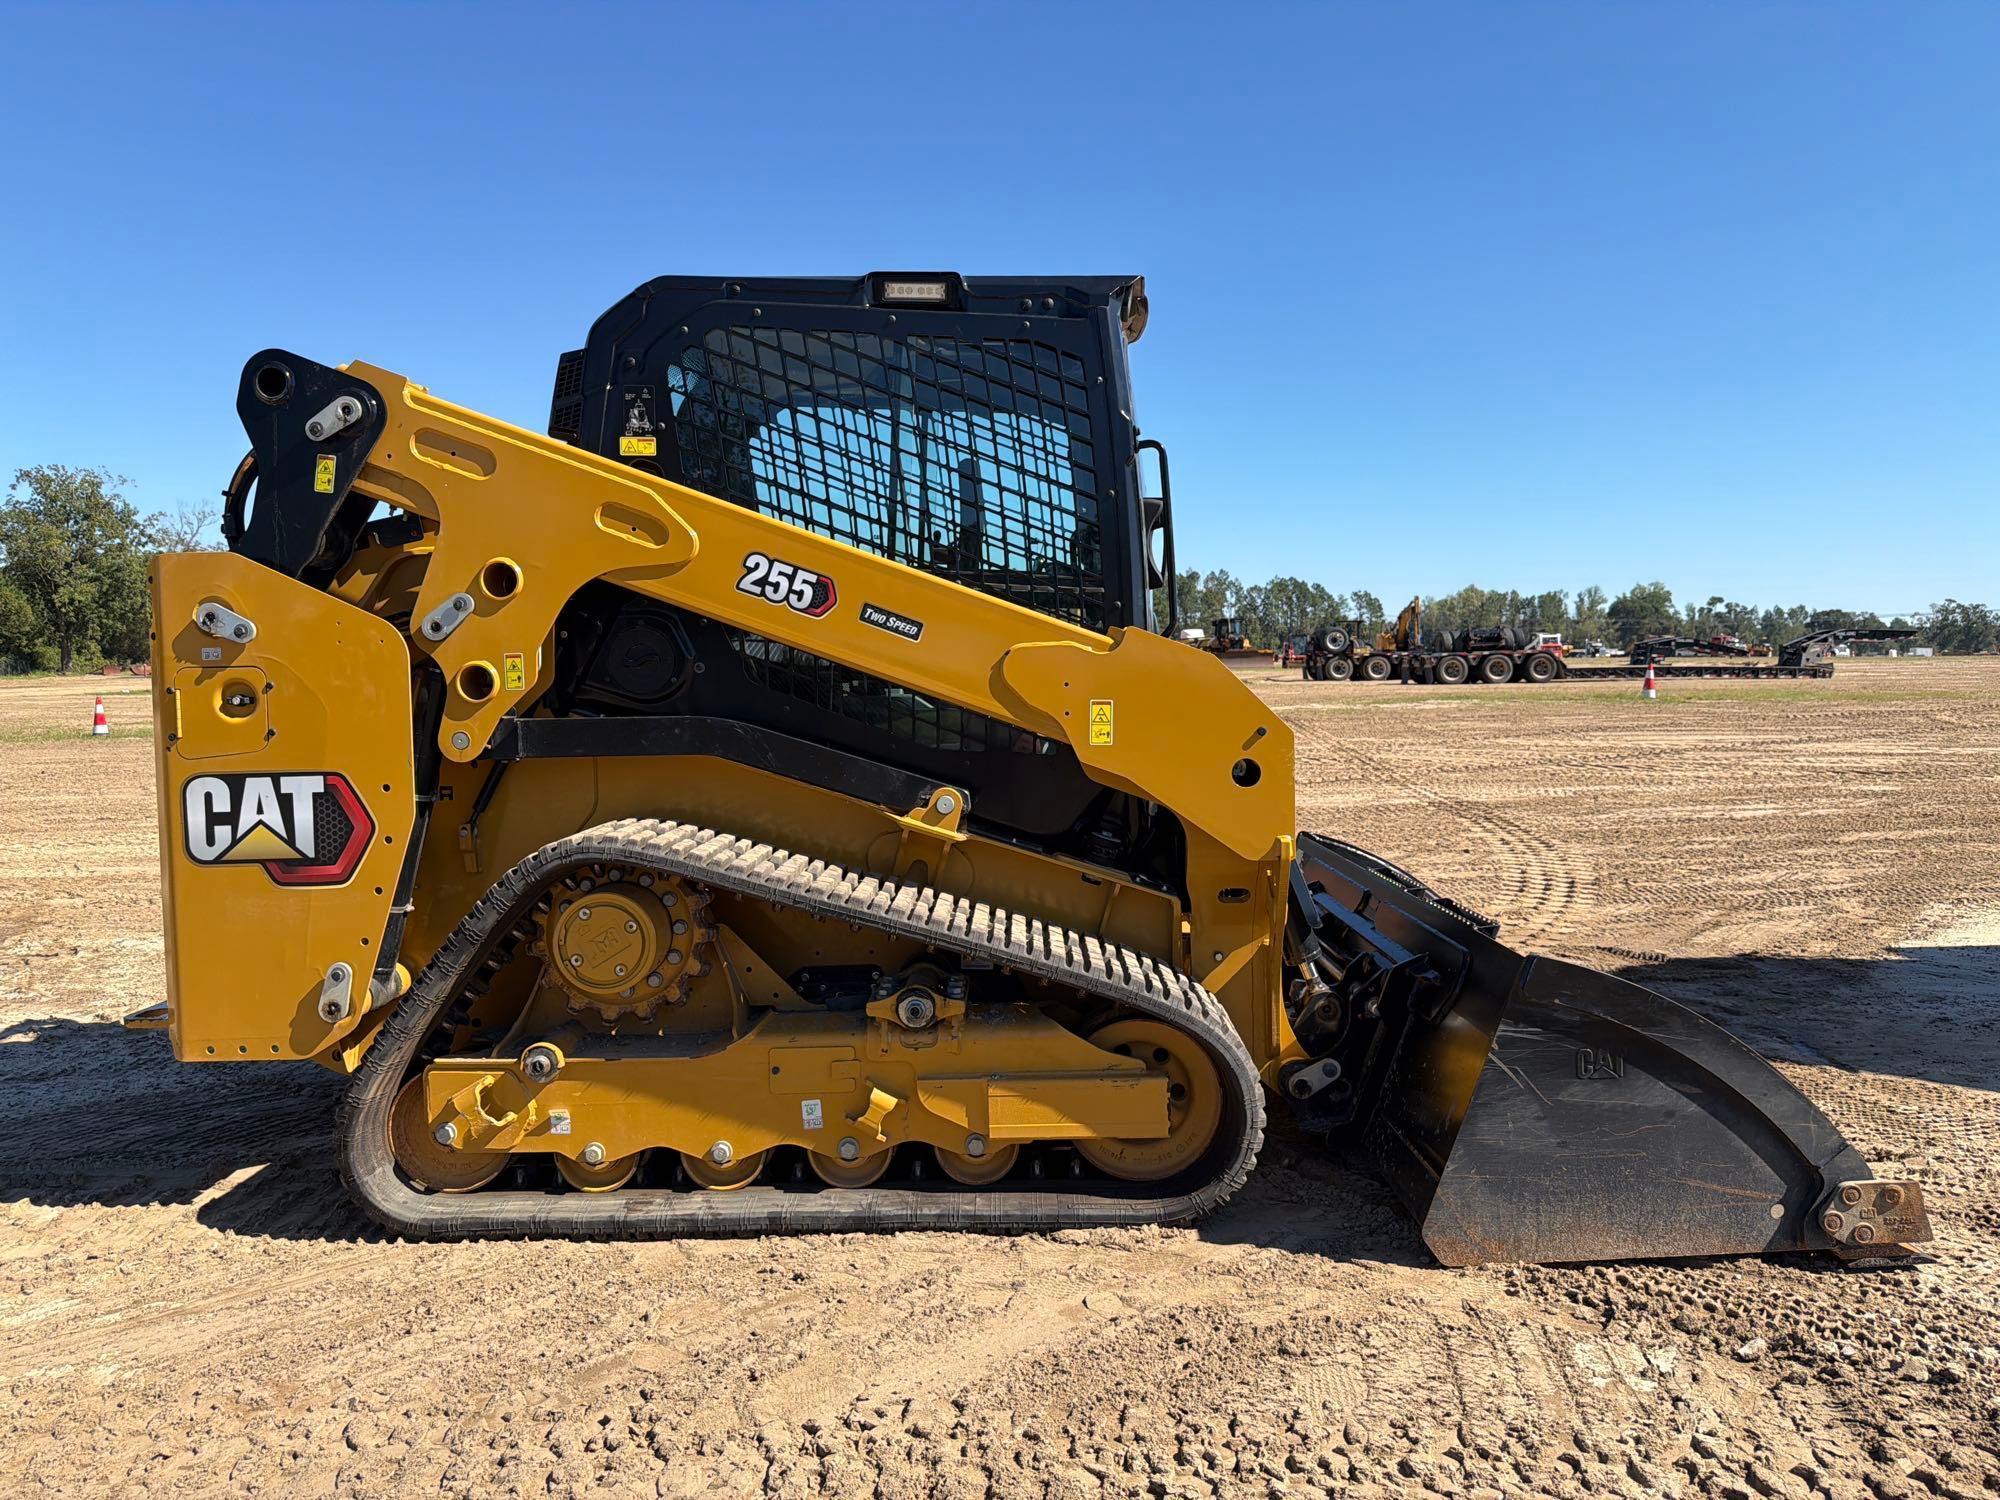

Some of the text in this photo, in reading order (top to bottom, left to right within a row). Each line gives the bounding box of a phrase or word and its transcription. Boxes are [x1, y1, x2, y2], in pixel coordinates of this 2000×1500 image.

[738, 553, 819, 610] 255
[185, 775, 325, 861] CAT
[1576, 1048, 1624, 1080] CAT
